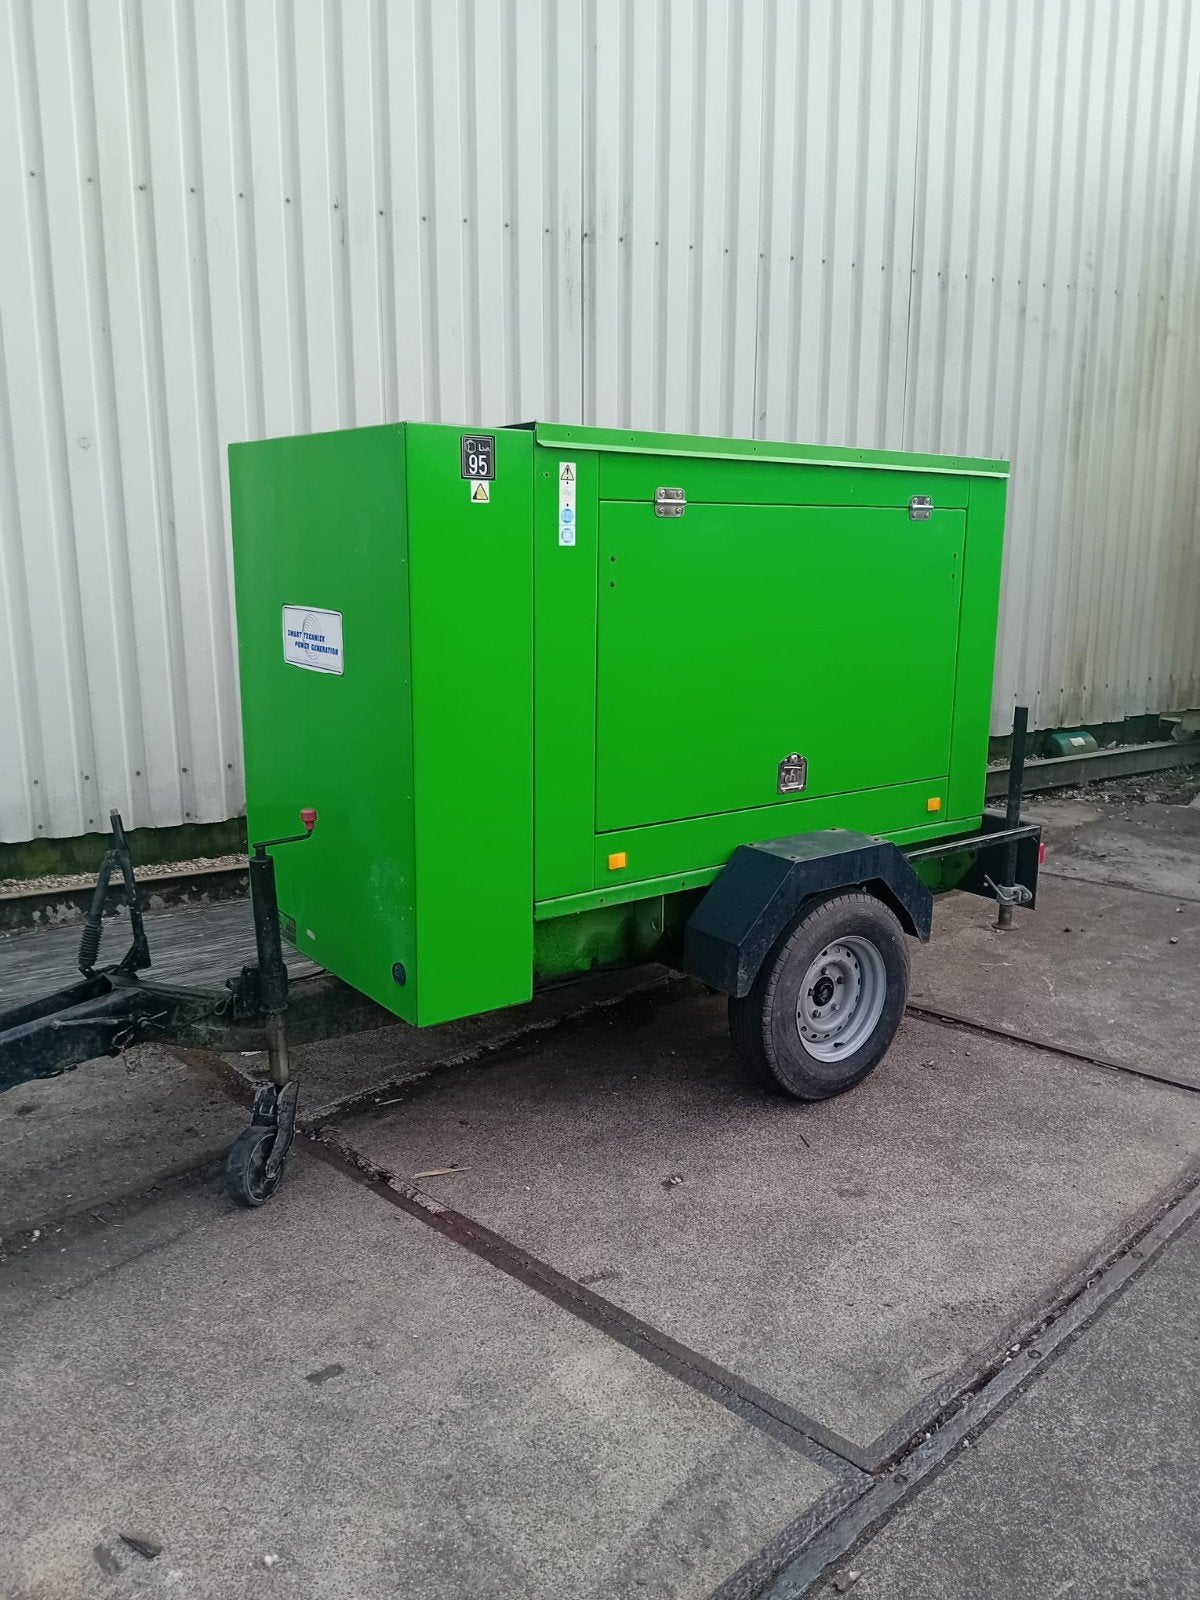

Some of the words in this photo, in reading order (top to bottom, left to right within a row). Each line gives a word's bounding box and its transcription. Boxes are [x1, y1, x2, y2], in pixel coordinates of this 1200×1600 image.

[469, 455, 487, 475] 95
[288, 630, 302, 638] SMART
[303, 632, 325, 643] TECHNIEK
[295, 641, 309, 651] POWER
[311, 644, 338, 656] GENERATION
